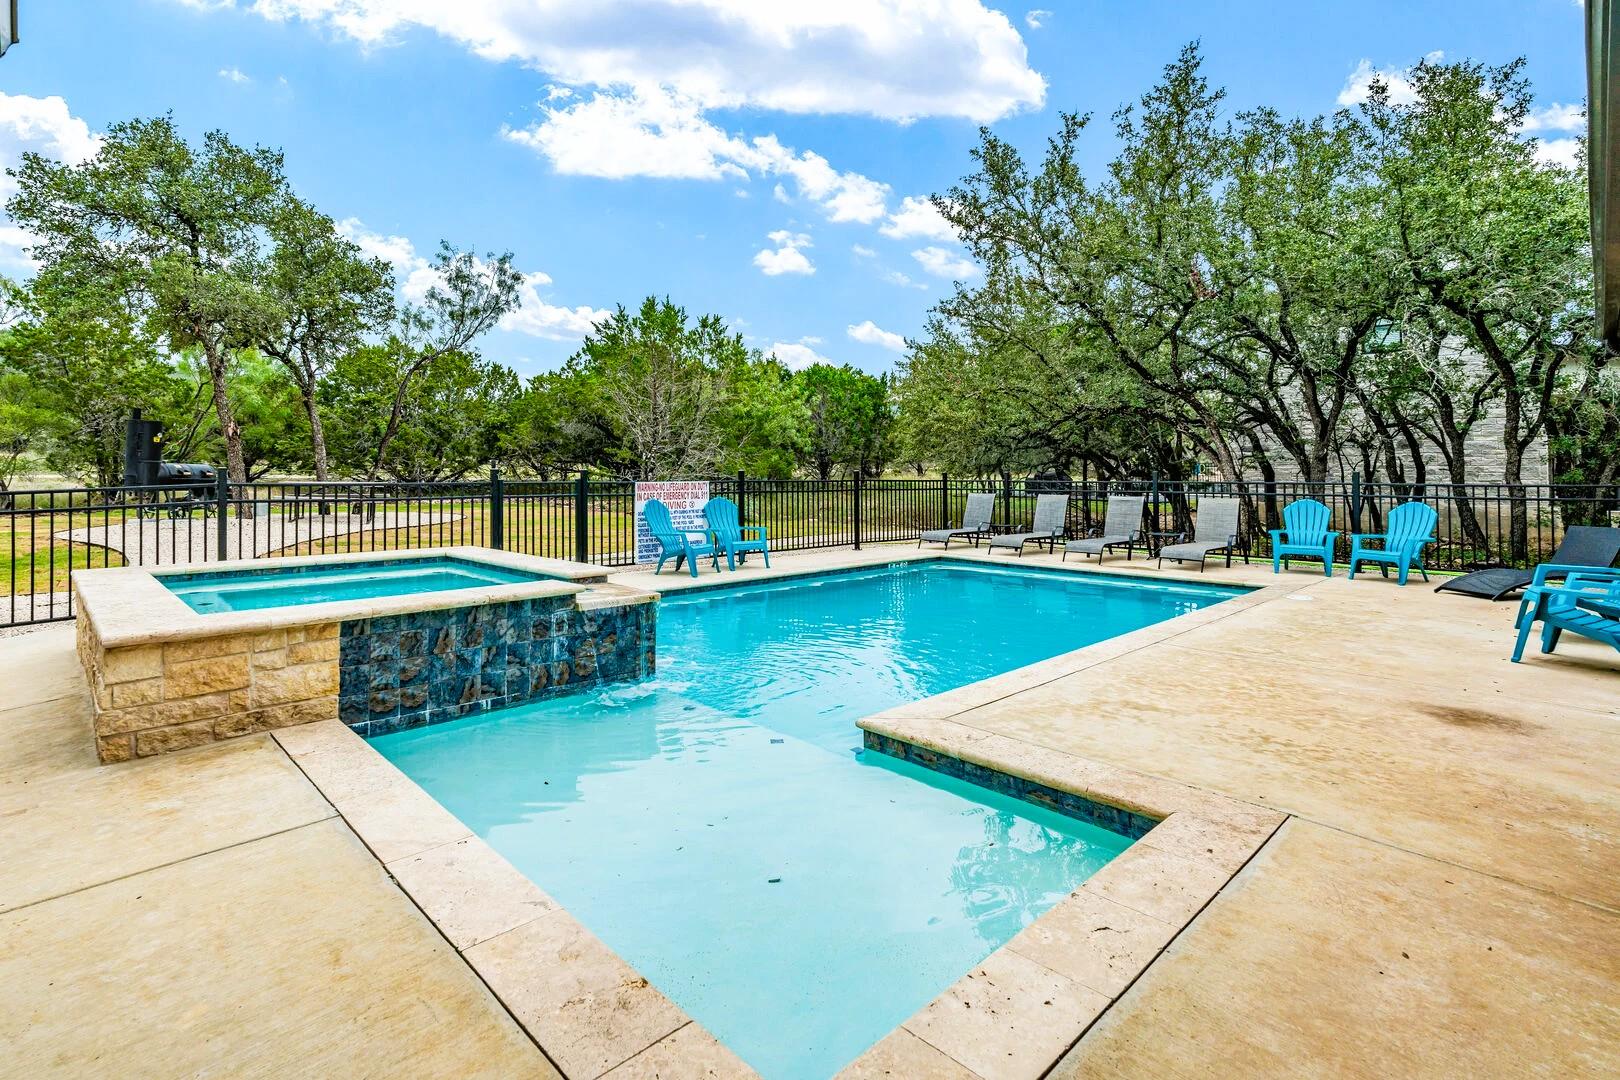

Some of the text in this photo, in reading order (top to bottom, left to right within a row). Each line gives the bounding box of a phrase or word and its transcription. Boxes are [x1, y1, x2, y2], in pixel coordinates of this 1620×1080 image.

[666, 482, 689, 491] LIFEGUARD
[691, 482, 697, 491] ON
[698, 482, 708, 490] DUTY
[637, 492, 643, 501] IN
[643, 492, 656, 501] CASE
[656, 492, 662, 500] OF
[663, 491, 690, 500] EMERGENCY
[691, 491, 701, 500] DIAL
